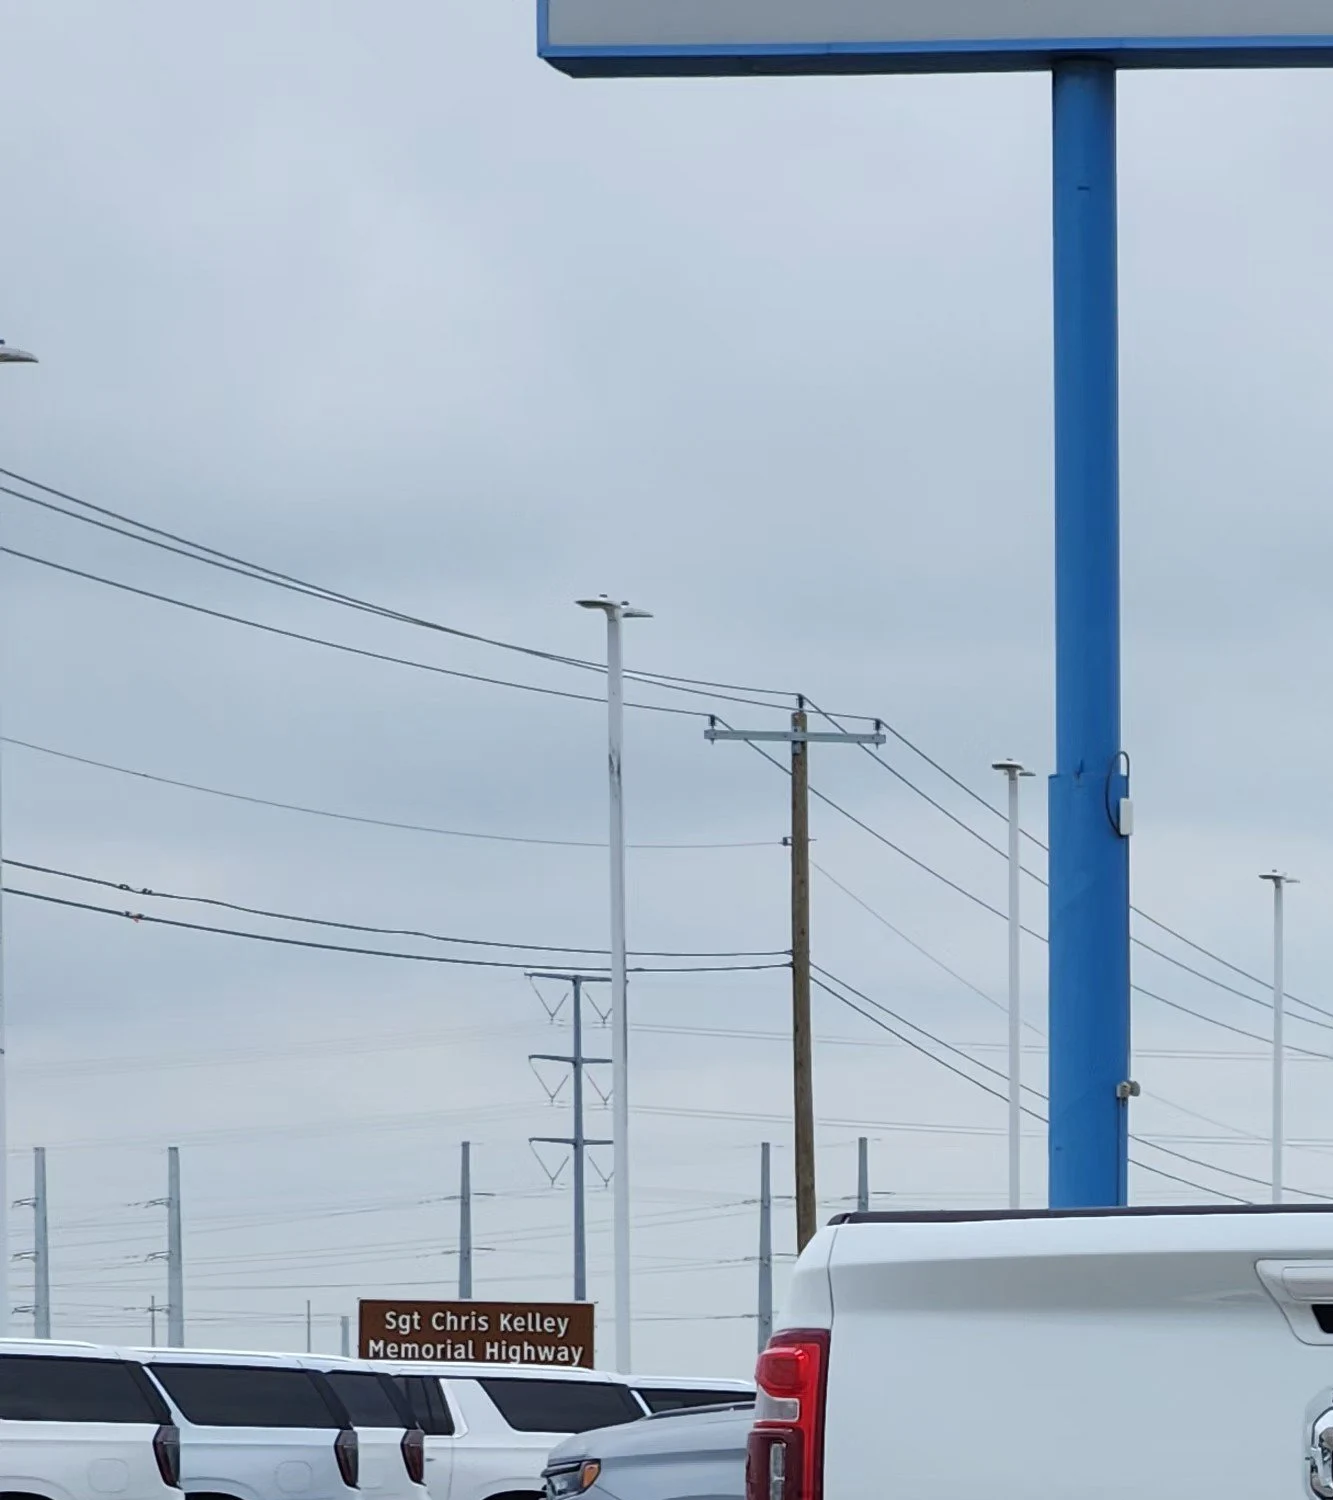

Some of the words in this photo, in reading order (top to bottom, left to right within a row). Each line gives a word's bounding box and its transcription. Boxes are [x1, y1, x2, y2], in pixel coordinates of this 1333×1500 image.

[385, 1311, 421, 1335] Sgt
[431, 1311, 489, 1332] Chris
[500, 1313, 569, 1338] Kelley
[368, 1339, 475, 1360] Memorial
[485, 1341, 583, 1366] Highway
